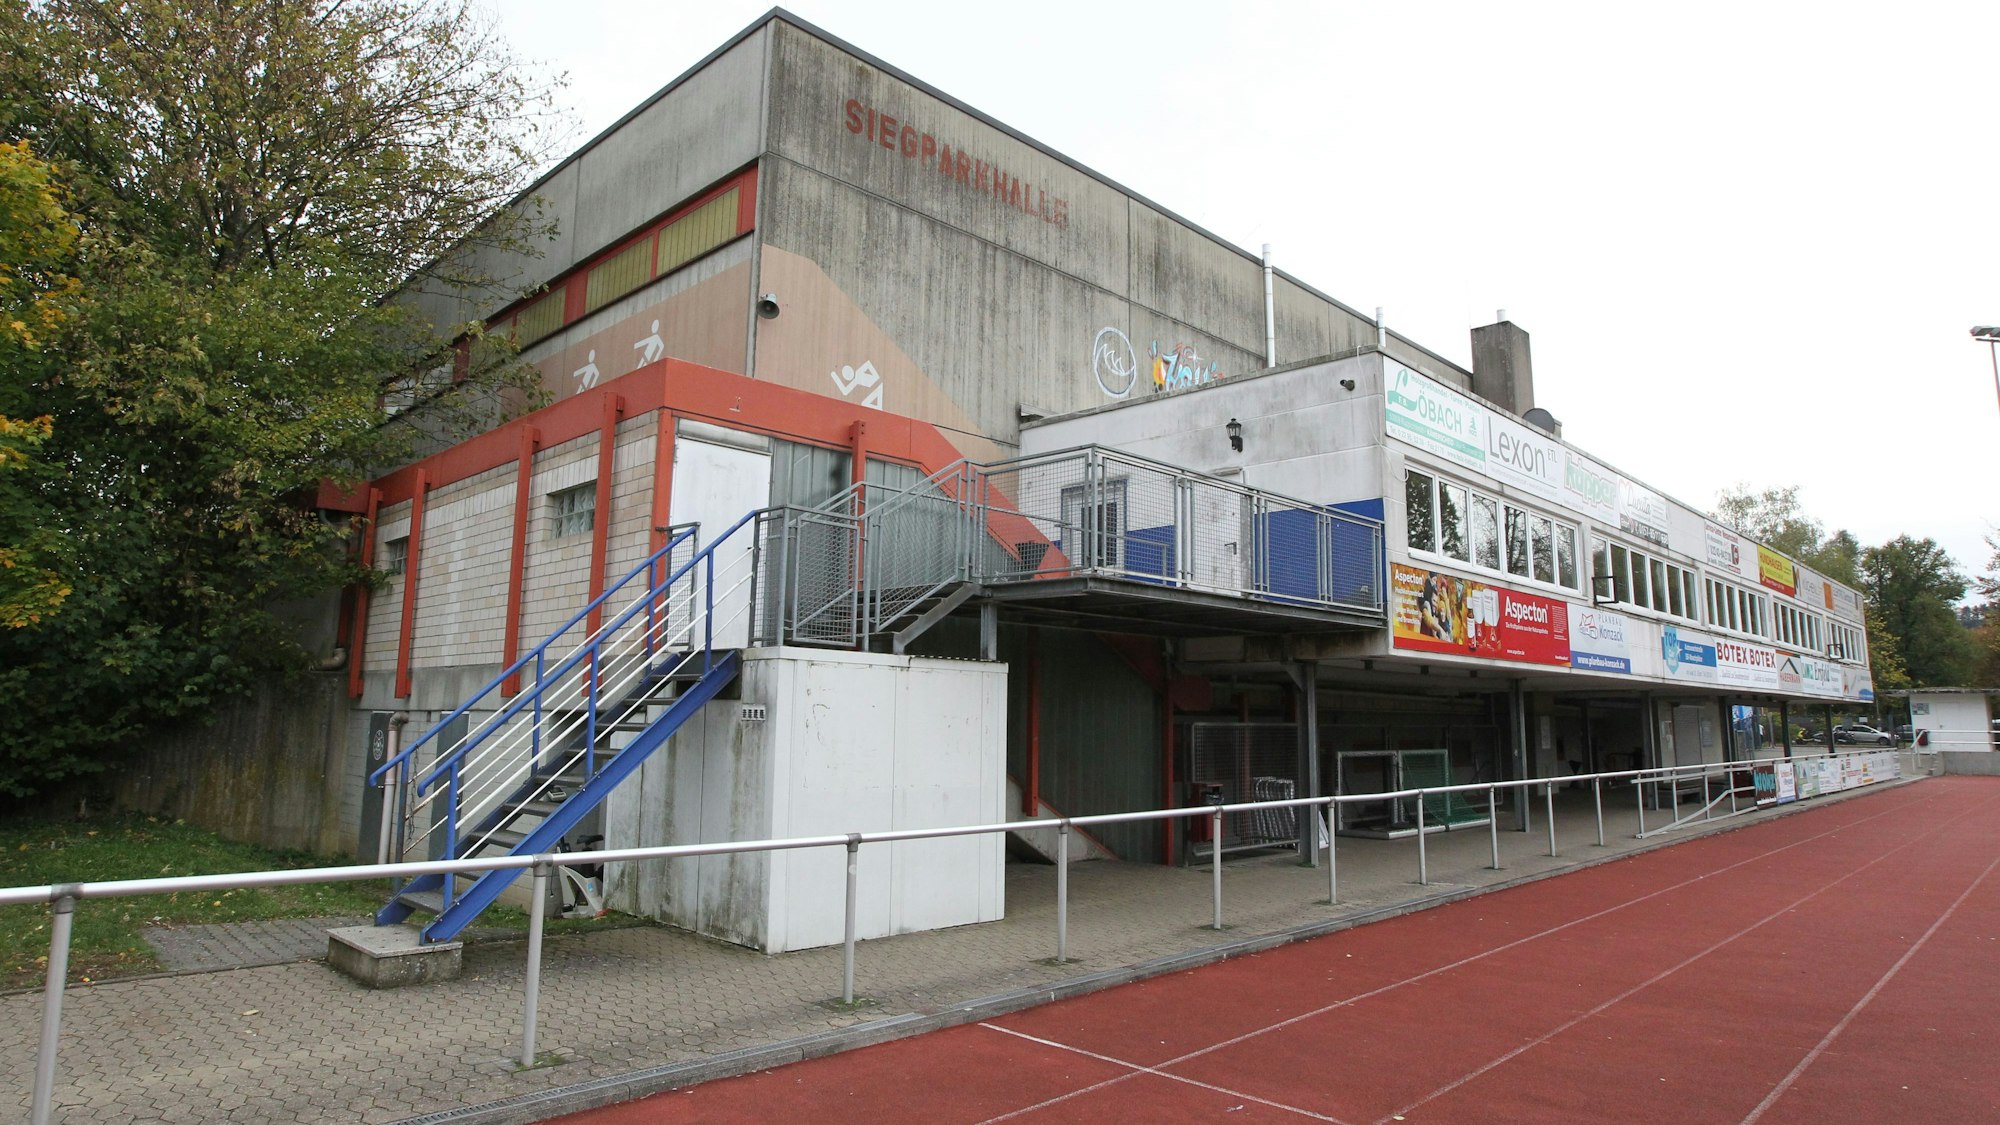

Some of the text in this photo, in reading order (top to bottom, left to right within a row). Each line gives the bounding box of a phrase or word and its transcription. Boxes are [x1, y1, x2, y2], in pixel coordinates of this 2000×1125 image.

[846, 99, 1069, 228] SIEGPARKHALLE
[1488, 415, 1546, 478] Lexon
[1547, 448, 1557, 463] ETL
[1505, 596, 1549, 624] Aspecton
[1598, 613, 1622, 627] PLANBAU
[1599, 624, 1624, 642] Konzack
[1716, 642, 1748, 665] BOTEX
[1749, 648, 1777, 668] BOTEX
